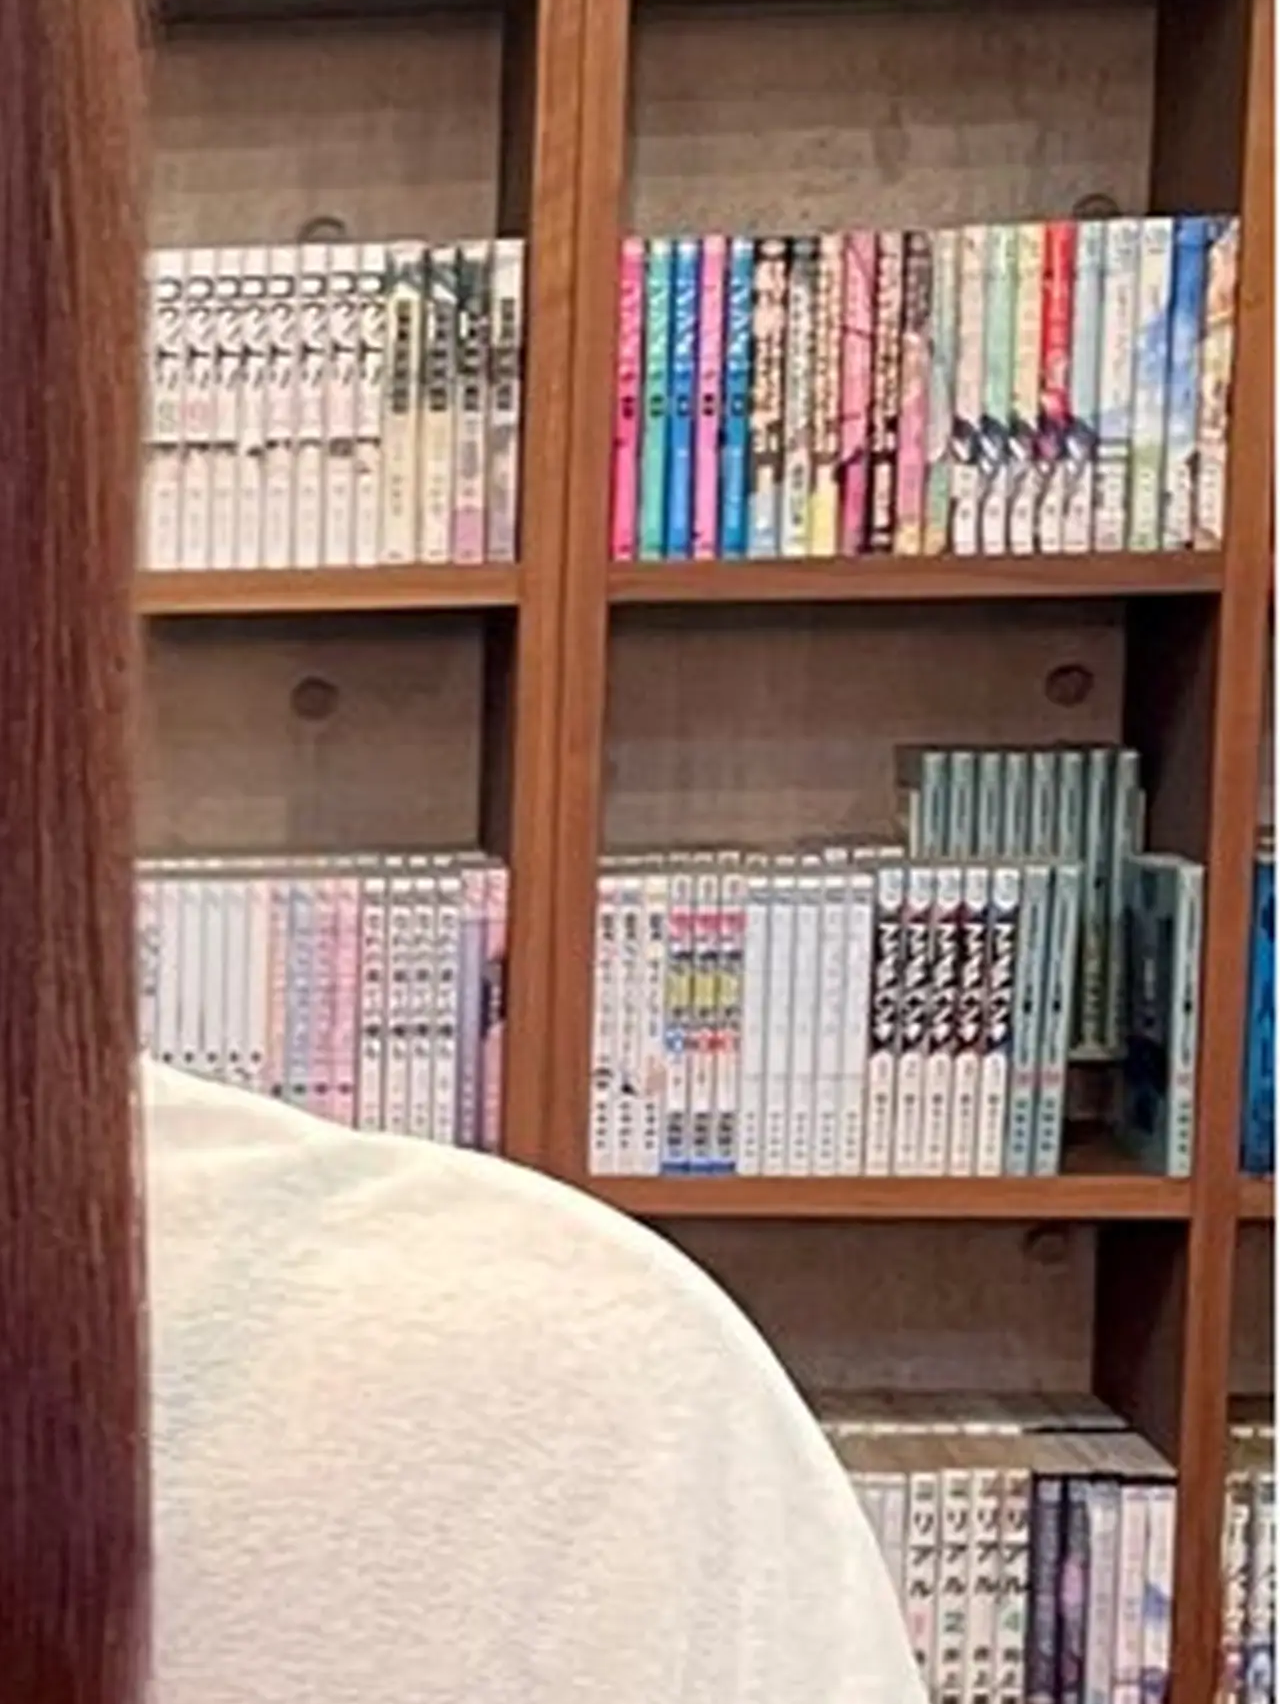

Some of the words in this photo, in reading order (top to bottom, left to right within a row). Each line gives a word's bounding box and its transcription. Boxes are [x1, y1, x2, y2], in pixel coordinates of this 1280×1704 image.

[910, 1509, 934, 1597] リアル
[945, 1508, 968, 1595] リアル
[975, 1507, 999, 1594] リアル
[1004, 1505, 1030, 1593] リアル
